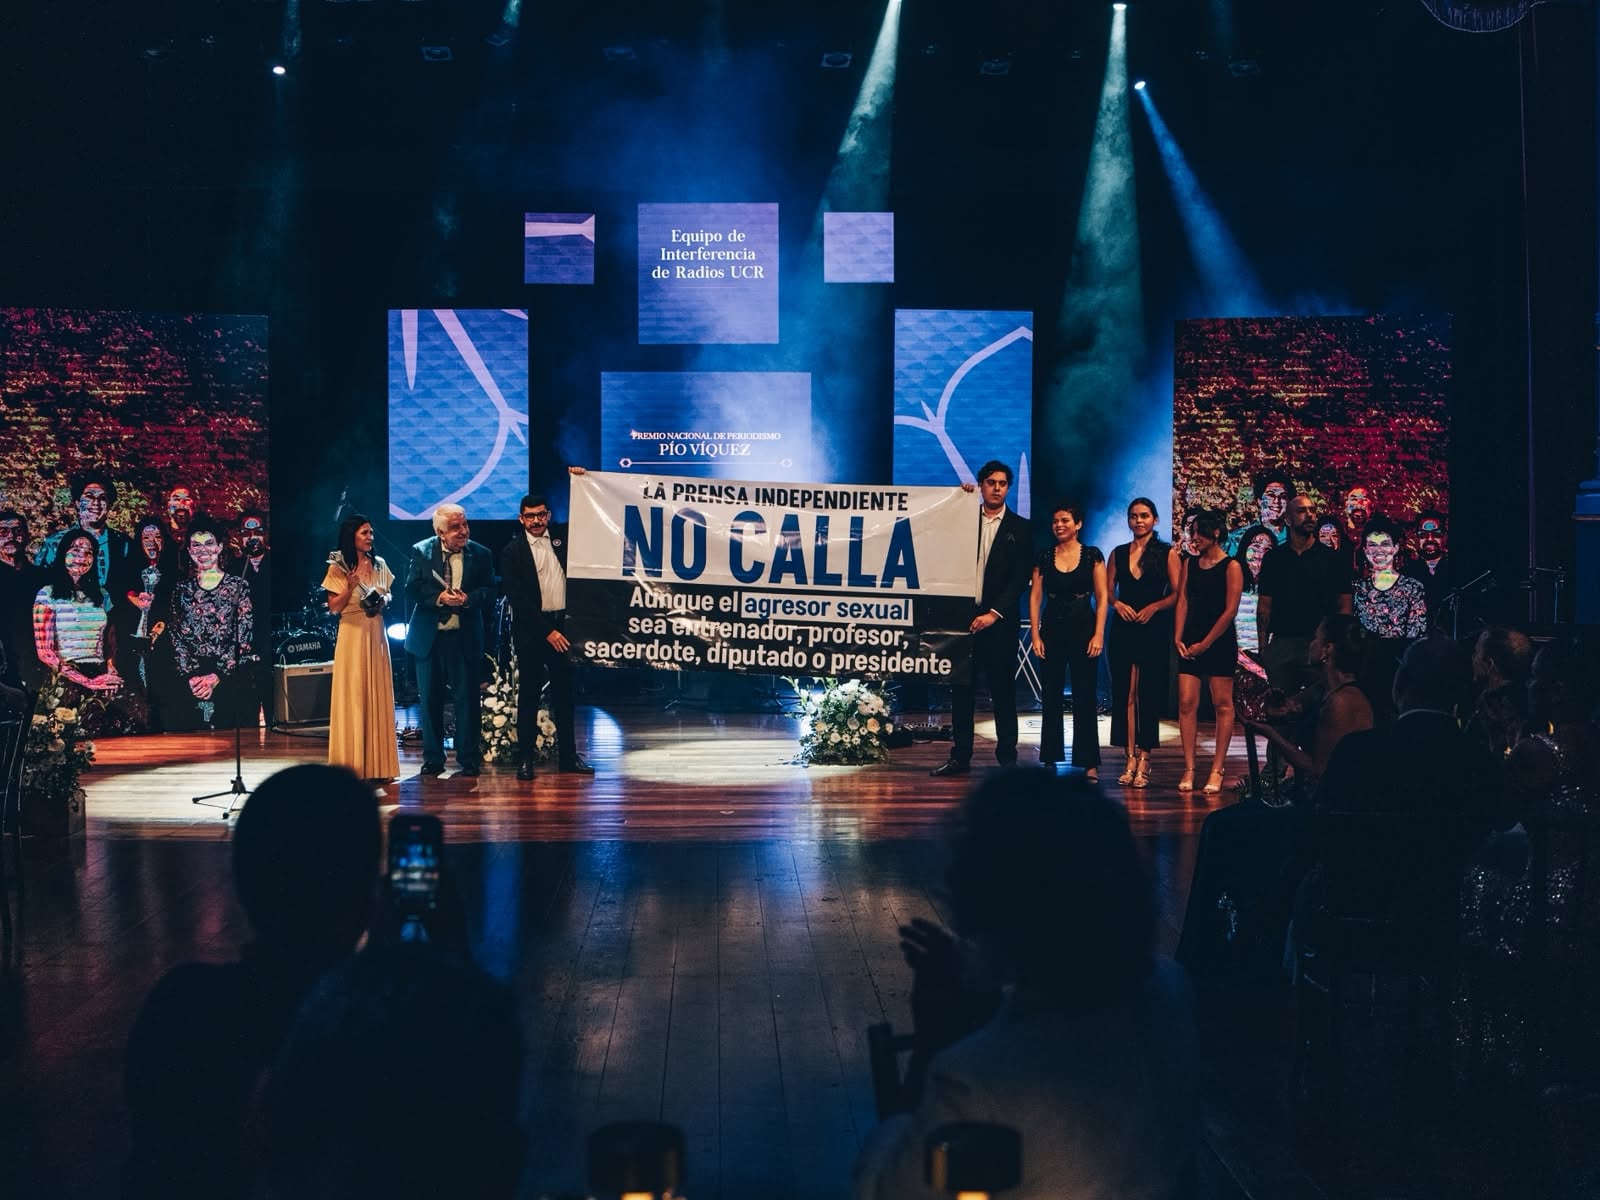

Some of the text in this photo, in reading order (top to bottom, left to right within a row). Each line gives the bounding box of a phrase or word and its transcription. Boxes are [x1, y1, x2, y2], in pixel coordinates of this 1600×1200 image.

[671, 229, 746, 246] Equipo de
[660, 247, 756, 261] Interferencia
[651, 265, 765, 279] de Radios UCR
[631, 432, 781, 440] PREMIO NACIONAL DE PERIODISMO
[658, 440, 751, 458] PÍO VÍQUEZ
[643, 481, 909, 512] LA PRENSA INDEPENDIENTE
[622, 504, 921, 590] NO CALLA
[629, 586, 910, 621] Aunque el agresor sexual
[628, 615, 909, 650] sea entrenador, profesor,
[295, 641, 322, 653] YAMAHA
[584, 639, 953, 676] sacerdote, diputado o presidente
